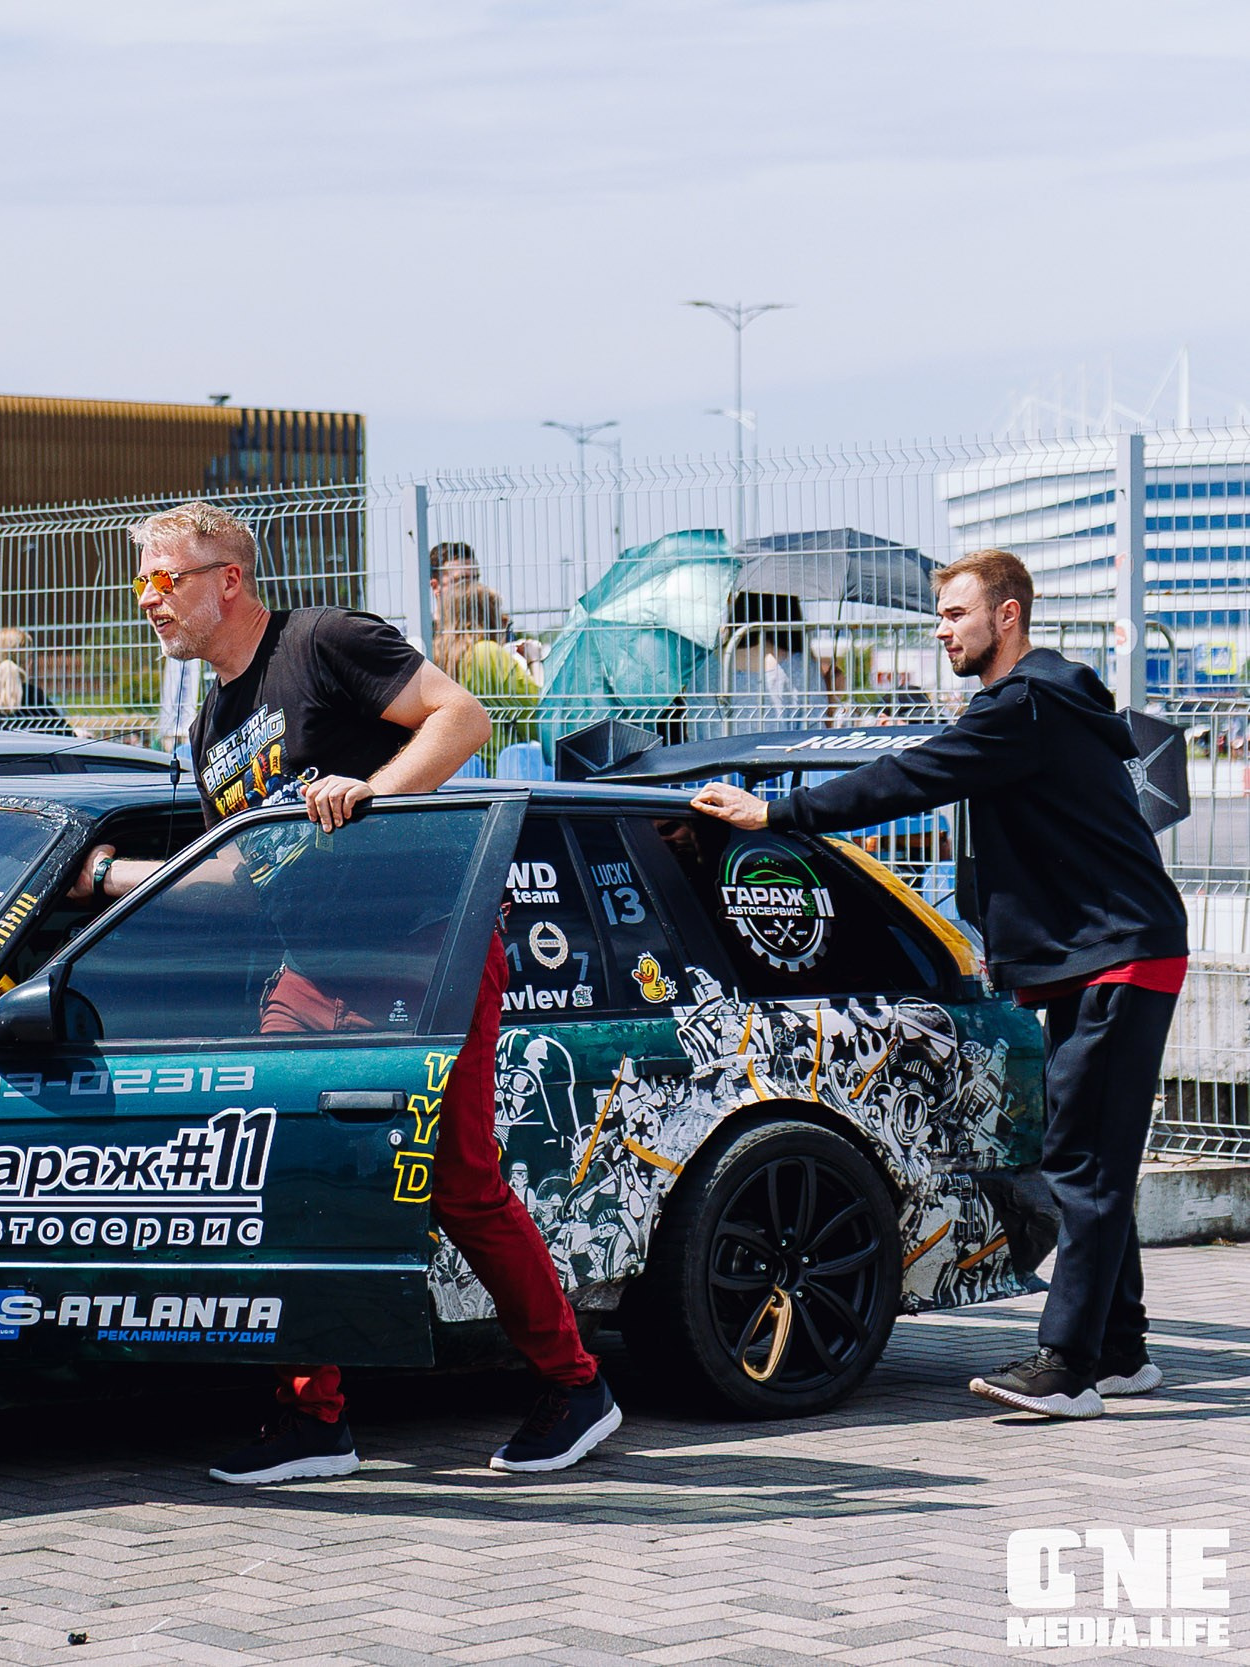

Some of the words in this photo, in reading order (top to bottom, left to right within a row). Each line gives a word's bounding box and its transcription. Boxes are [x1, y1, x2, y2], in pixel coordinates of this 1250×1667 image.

[208, 733, 239, 761] LEFT
[240, 704, 269, 740] FOOT
[202, 711, 285, 795] BRAKING
[591, 862, 633, 887] LUCKY
[512, 889, 560, 904] team
[602, 887, 646, 925] 13
[727, 906, 803, 916] АВТОСЕРВИС
[97, 1329, 201, 1342] РЕКЛАМНАЯ
[206, 1331, 276, 1343] СТУДИЯ
